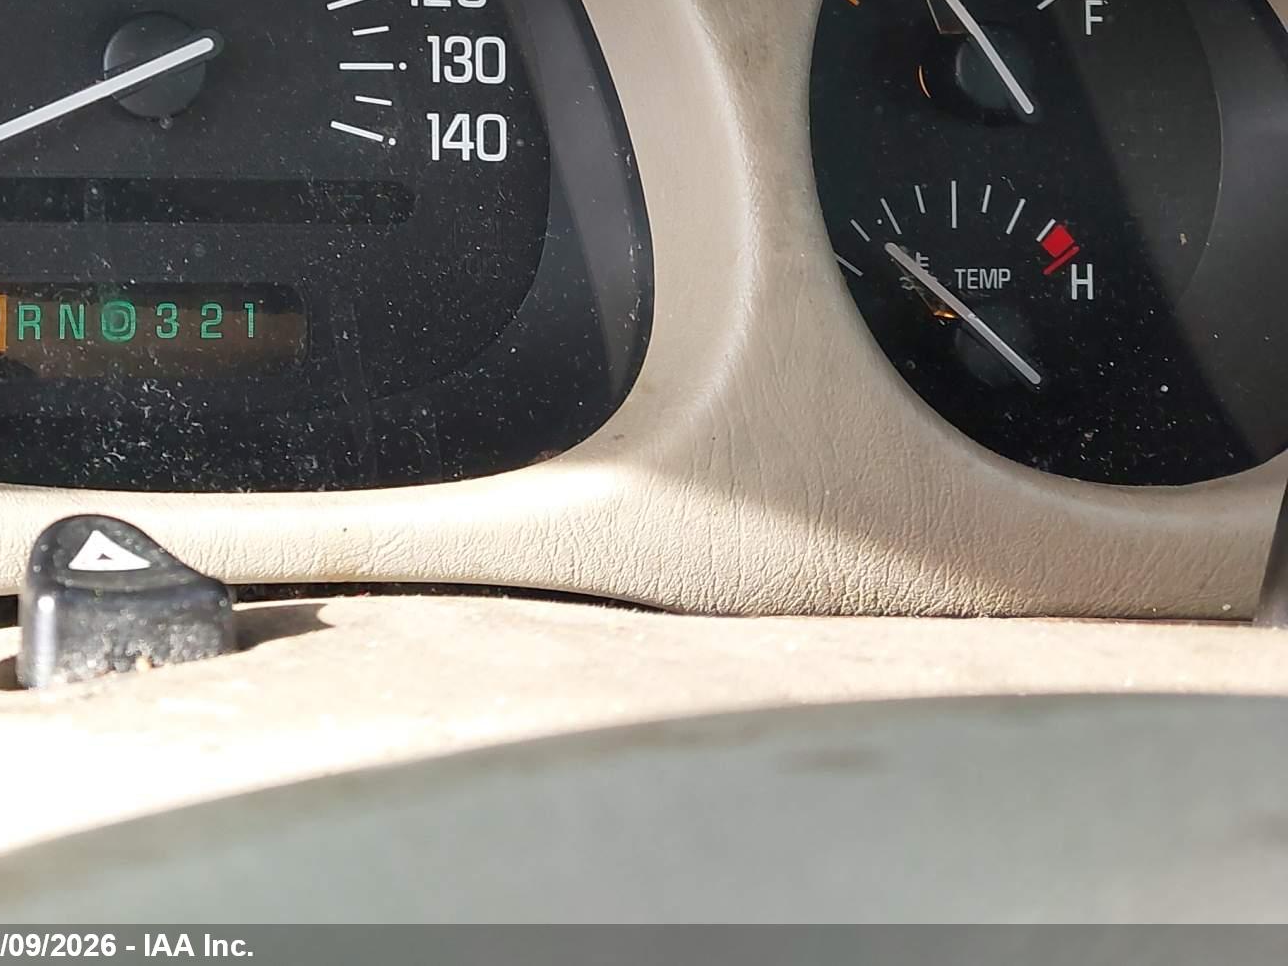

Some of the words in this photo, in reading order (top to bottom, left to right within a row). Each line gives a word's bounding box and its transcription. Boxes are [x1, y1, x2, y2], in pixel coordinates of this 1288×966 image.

[1085, 0, 1103, 36] F
[427, 35, 506, 84] 130
[426, 113, 507, 162] 140
[954, 268, 1011, 290] TEMP
[1071, 263, 1094, 300] H
[18, 304, 41, 340] R
[59, 303, 85, 340] N
[156, 303, 180, 339] 3
[201, 303, 223, 339] 2
[244, 303, 254, 338] 1
